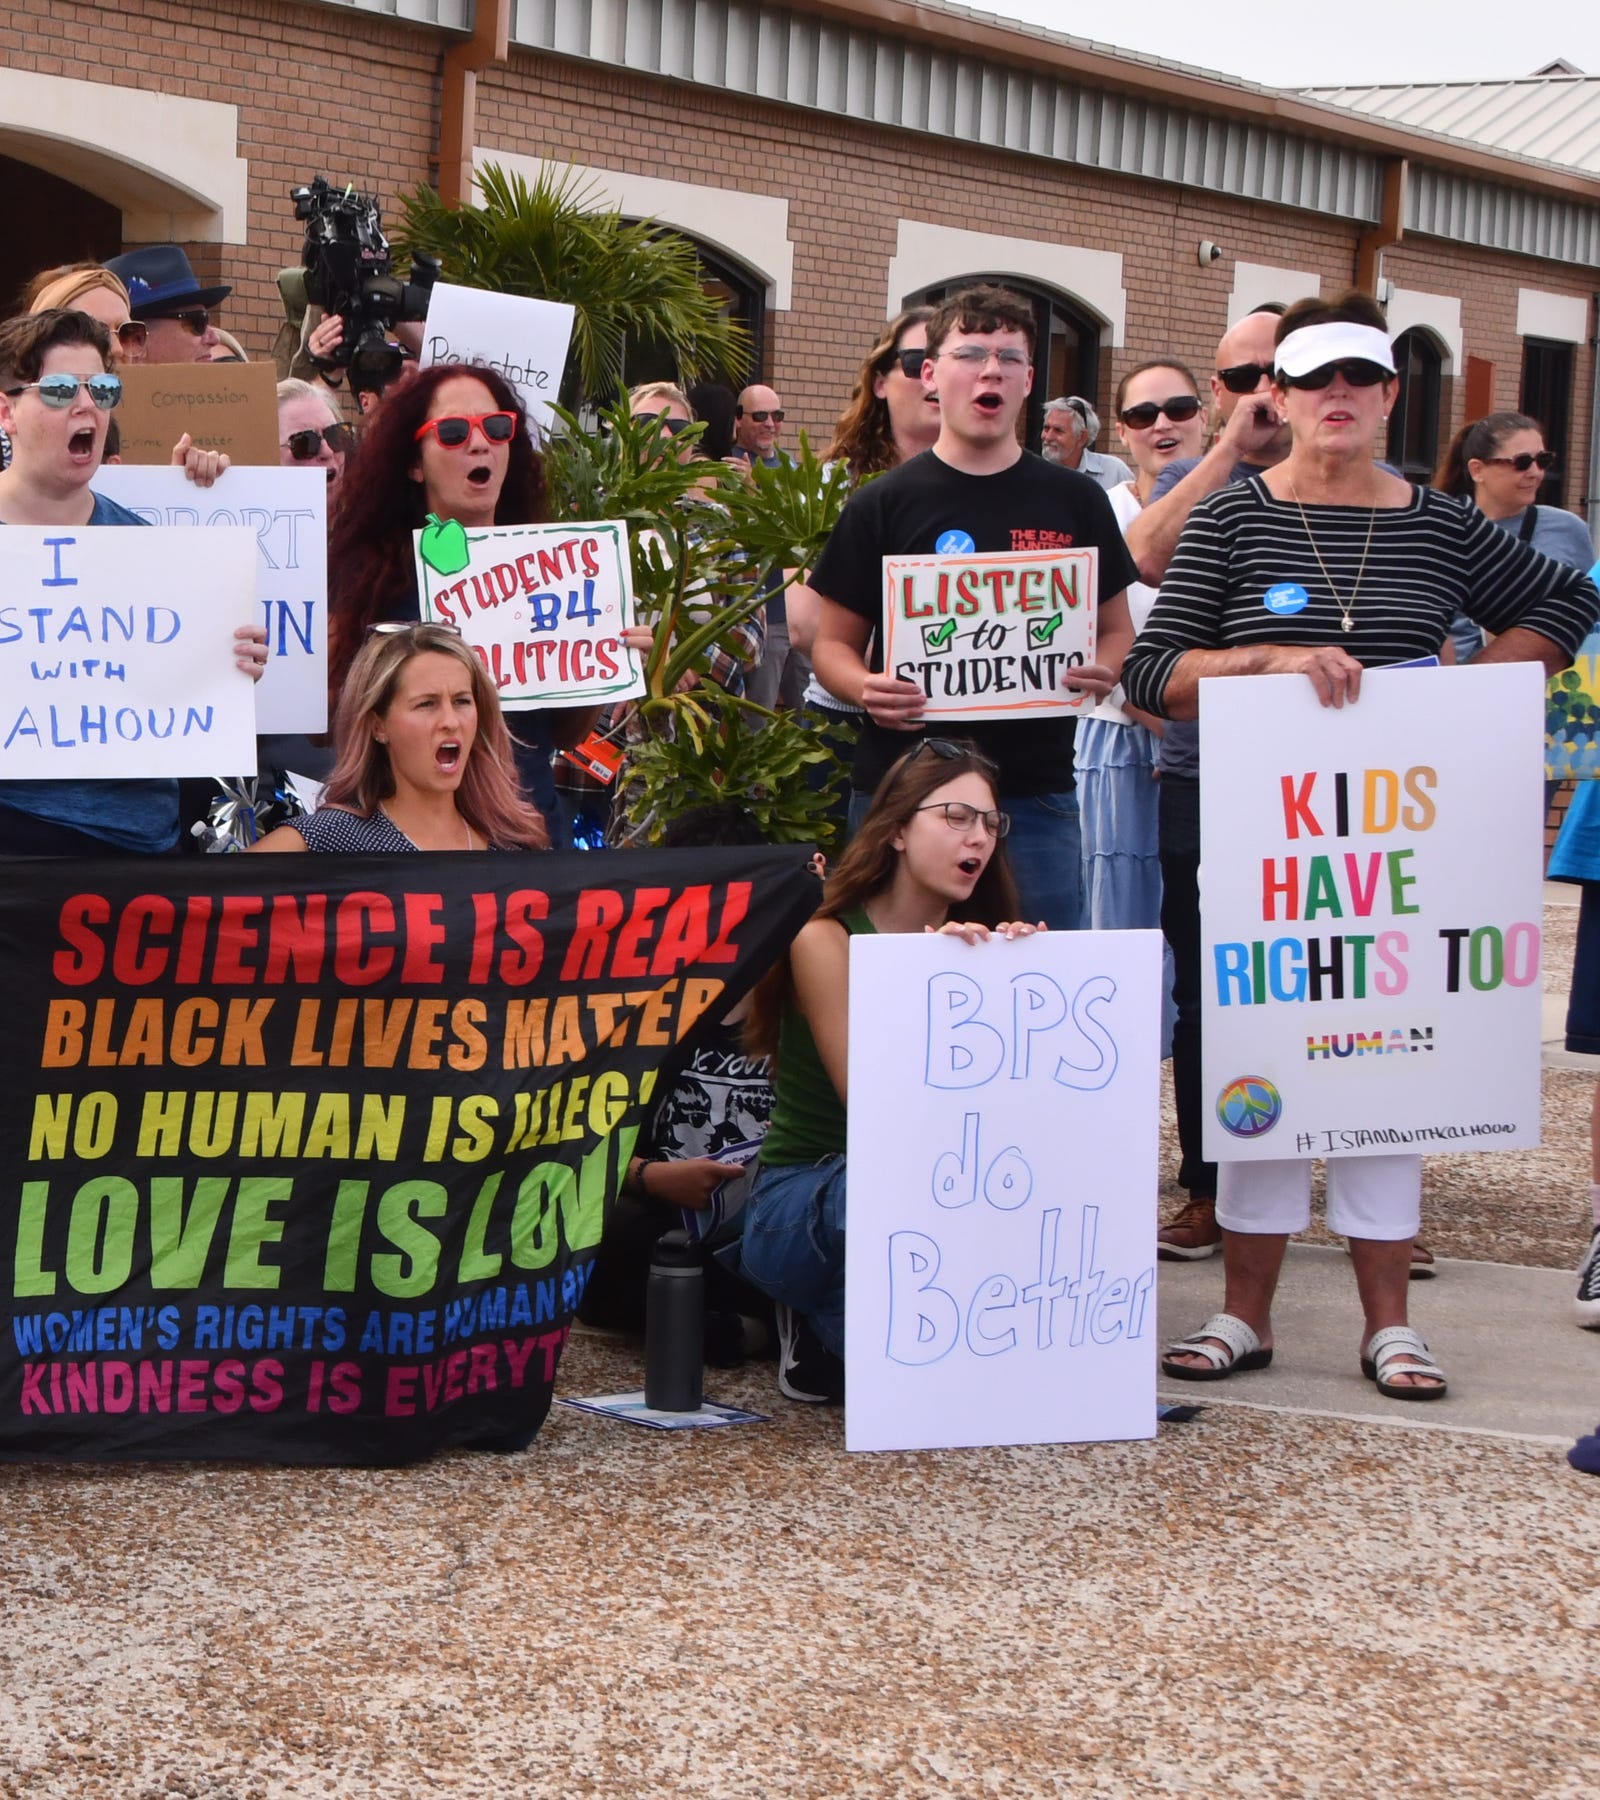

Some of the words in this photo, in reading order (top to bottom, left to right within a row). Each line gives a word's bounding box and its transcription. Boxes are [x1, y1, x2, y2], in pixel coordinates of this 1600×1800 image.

[151, 387, 249, 415] Compassion
[191, 436, 234, 446] reater
[42, 537, 78, 586] I
[1009, 529, 1036, 540] THE
[434, 538, 600, 626] STUDENTS
[528, 579, 602, 633] B4
[902, 563, 1079, 619] LISTEN
[31, 660, 126, 682] WITH
[472, 638, 619, 690] LITICS
[954, 619, 1017, 651] to
[1281, 766, 1438, 839] KIDS
[1262, 849, 1419, 921] HAVE
[53, 891, 445, 985] SCIENCE
[468, 890, 550, 986] IS
[559, 881, 752, 981] REAL
[1214, 931, 1409, 1006] RIGHTS
[1439, 922, 1541, 993] TOO
[41, 997, 275, 1068] BLACK
[290, 998, 488, 1072] LIVES
[503, 978, 726, 1071] MATTER
[925, 972, 1118, 1090] BPS
[1307, 1027, 1433, 1060] HUMAN
[713, 1053, 773, 1076] YOUT
[28, 1091, 119, 1161] NO
[136, 1091, 406, 1162] HUMAN
[423, 1094, 499, 1163] IS
[932, 1112, 1033, 1210] do
[14, 1175, 294, 1297] LOVE
[323, 1179, 448, 1298] IS
[13, 1304, 181, 1356] WOMEN'S
[194, 1304, 347, 1352] RIGHTS
[359, 1310, 437, 1356] ARE
[443, 1278, 556, 1346] HUMAN
[886, 1205, 1154, 1366] Better
[20, 1358, 285, 1415] KINDNESS
[306, 1361, 362, 1415] IS
[385, 1325, 570, 1417] EVERYT
